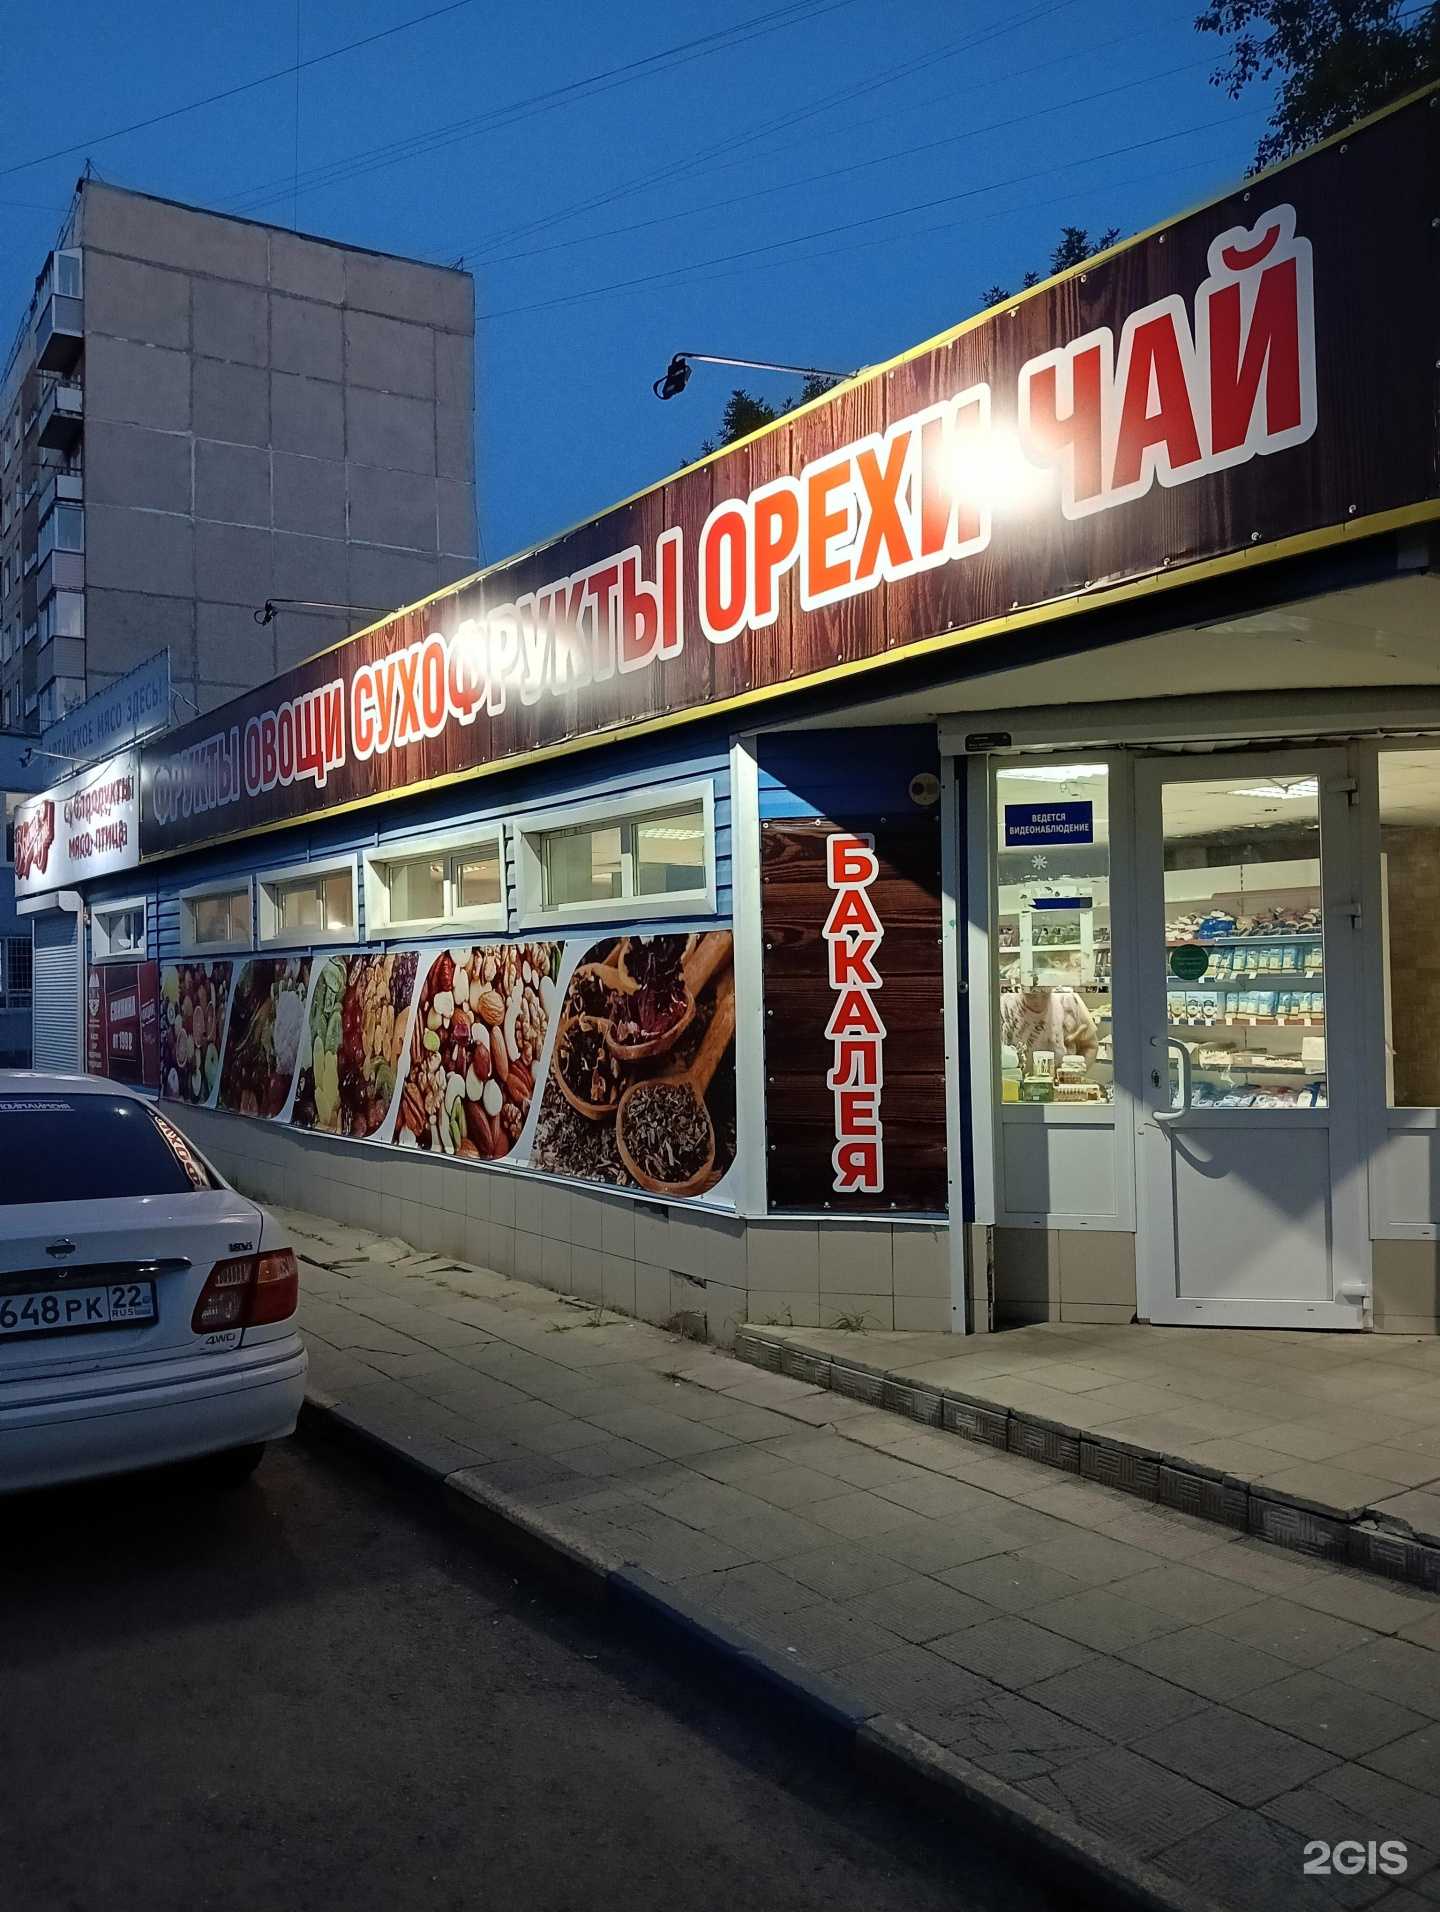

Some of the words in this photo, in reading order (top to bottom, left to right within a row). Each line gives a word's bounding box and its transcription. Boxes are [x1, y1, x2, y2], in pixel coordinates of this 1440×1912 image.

[244, 678, 346, 797] ОВОЩИ
[351, 526, 683, 761] СУХОФРУКТЫ
[699, 382, 992, 645] ОРЕХИ
[1018, 203, 1318, 521] ЧАЙ
[1031, 812, 1066, 824] ВЕДЕТСЯ
[1009, 823, 1089, 836] ВИДЕОНАБЛЮДЕНИЕ
[822, 833, 886, 1193] БАКАЛЕЯ
[111, 1285, 141, 1308] 22
[111, 1307, 135, 1318] RUS
[205, 1333, 236, 1345] 4WD
